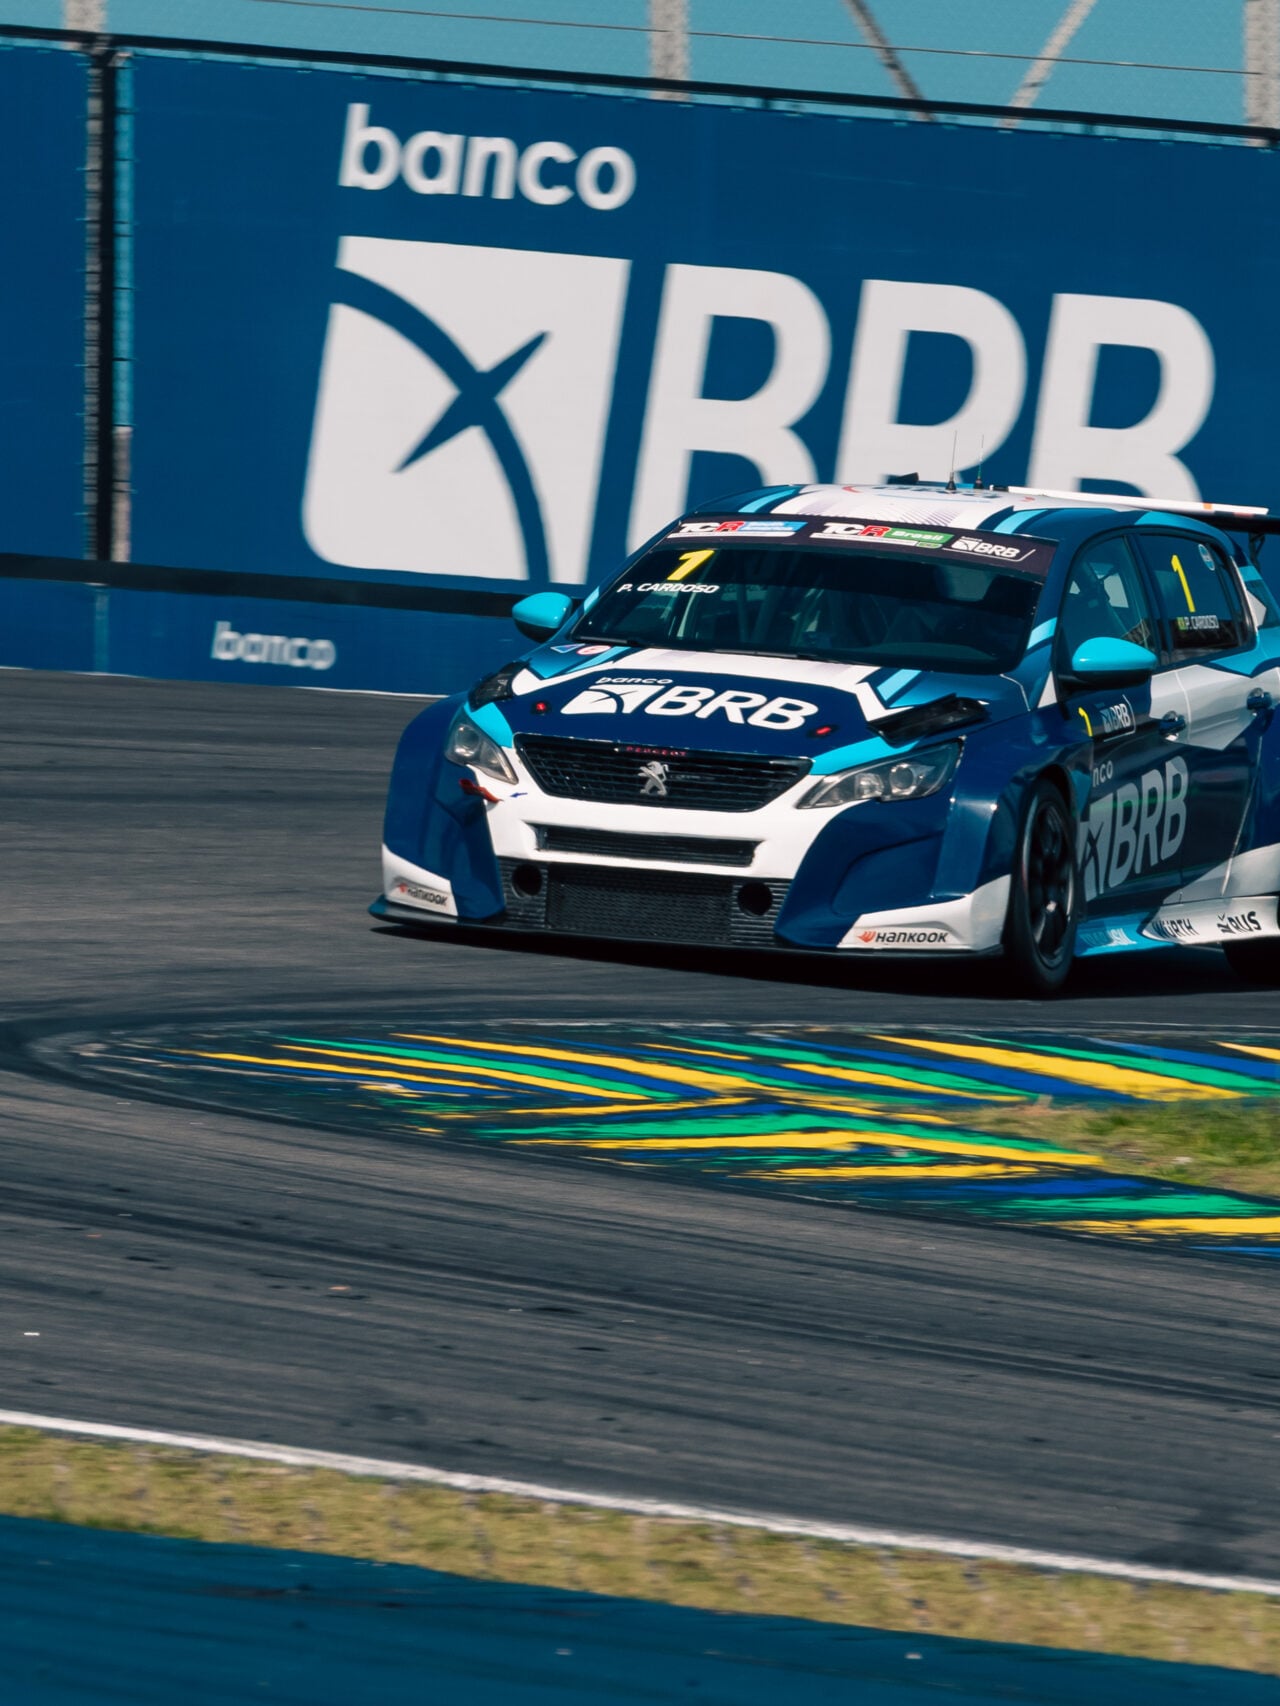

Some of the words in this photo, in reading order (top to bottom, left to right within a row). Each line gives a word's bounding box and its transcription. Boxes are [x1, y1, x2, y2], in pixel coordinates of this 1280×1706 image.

[338, 102, 637, 211] banco
[822, 522, 891, 538] TCR
[974, 542, 1021, 558] BRB
[665, 550, 715, 581] 1
[616, 583, 632, 593] P.
[637, 583, 720, 594] CARDOSO
[1171, 554, 1196, 613] 1
[211, 620, 337, 671] banco
[595, 676, 673, 685] banco
[644, 685, 819, 730] BRB
[1078, 707, 1093, 736] 1
[1109, 703, 1131, 731] BRB
[1108, 755, 1189, 889] BRB
